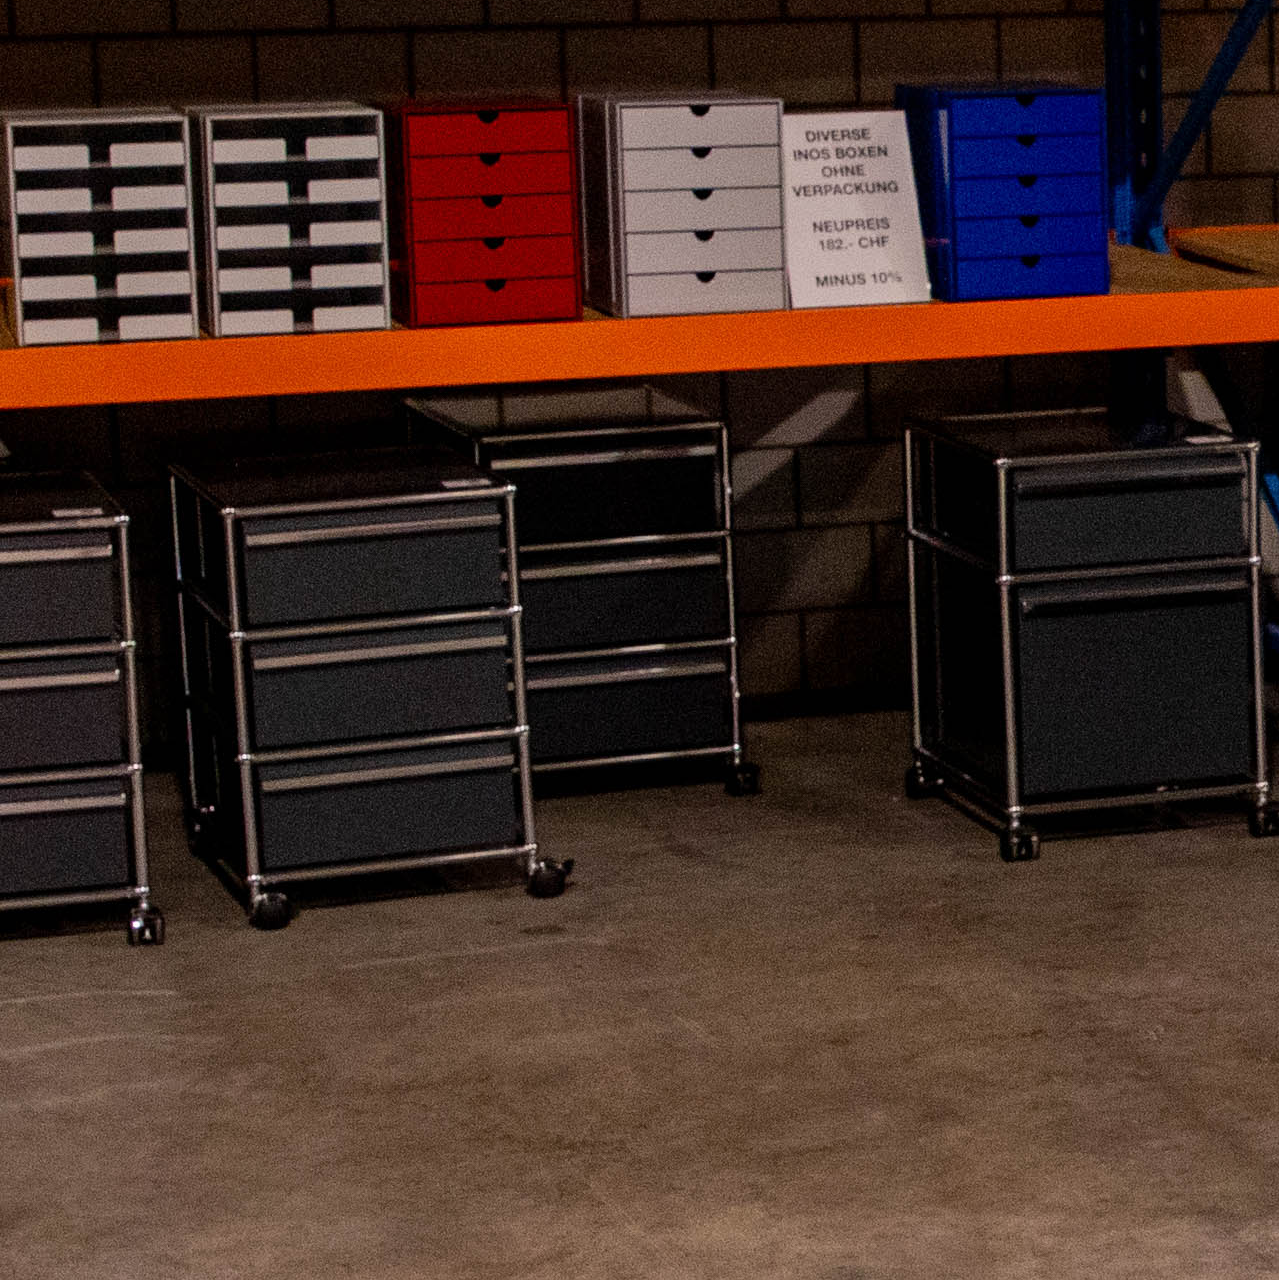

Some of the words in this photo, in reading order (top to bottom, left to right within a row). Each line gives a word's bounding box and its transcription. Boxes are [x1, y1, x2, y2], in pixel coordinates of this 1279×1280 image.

[805, 128, 871, 142] DIVERSE
[793, 148, 831, 161] INOS
[835, 145, 888, 159] BOXEN
[821, 164, 866, 177] OHNE
[792, 180, 899, 196] VERPACKUNG
[812, 217, 890, 233] NEUPREIS
[858, 236, 889, 249] CHF
[815, 273, 866, 287] MINUS
[871, 271, 904, 283] 10%
